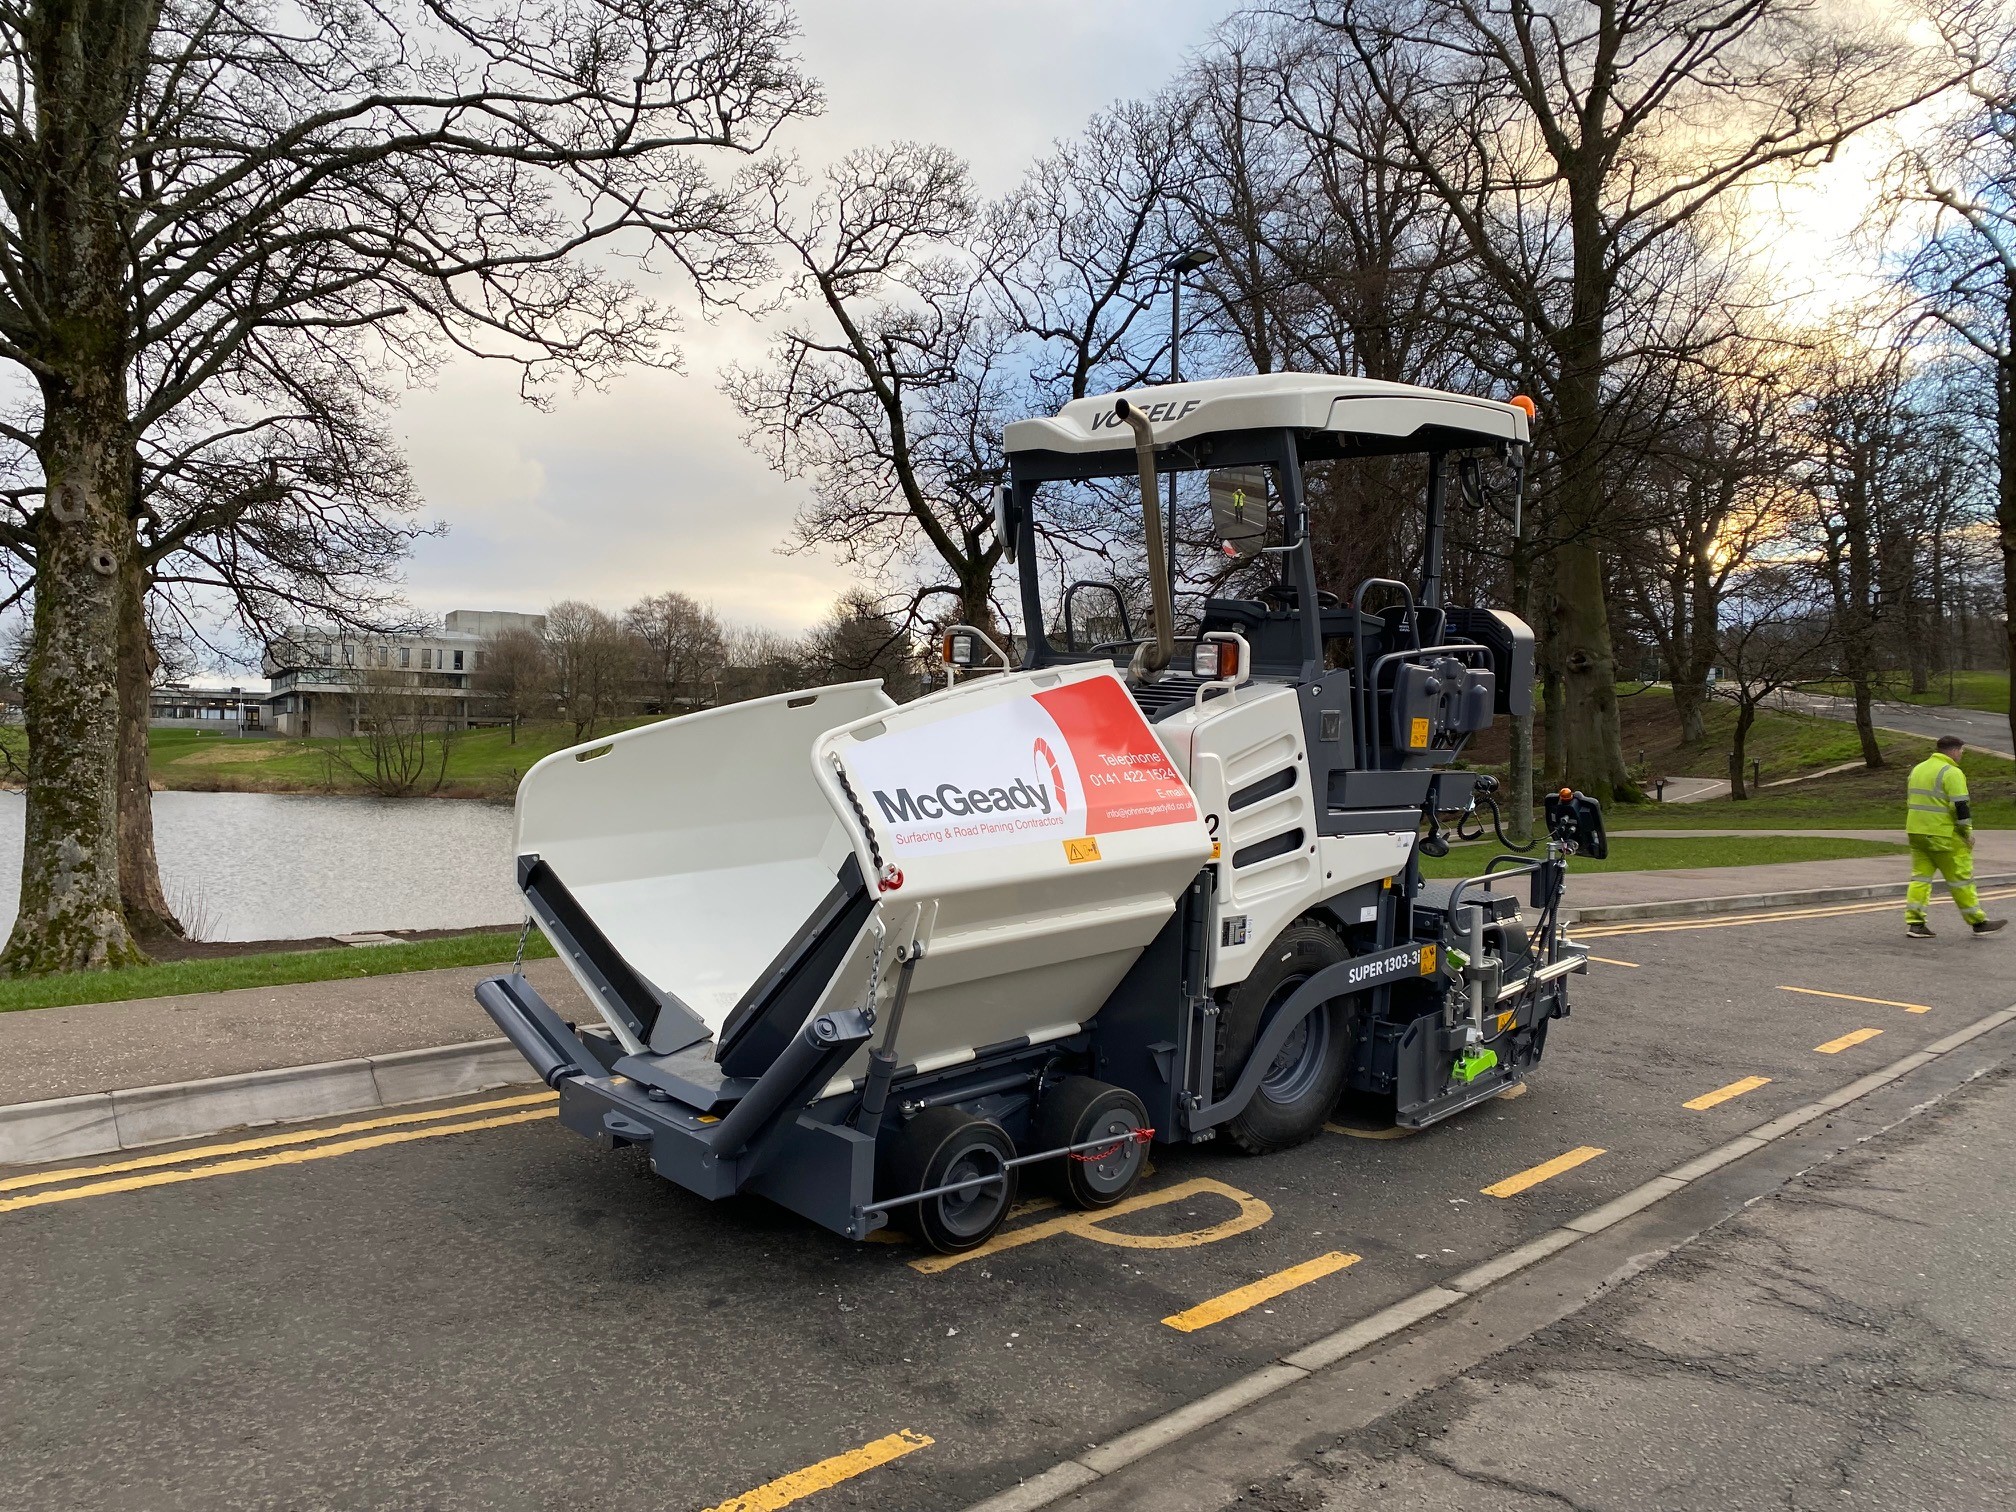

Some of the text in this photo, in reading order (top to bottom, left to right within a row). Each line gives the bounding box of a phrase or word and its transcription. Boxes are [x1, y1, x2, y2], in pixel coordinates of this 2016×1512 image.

[1098, 752, 1165, 767] Telephone:
[1089, 767, 1177, 787] 0141 422 1524
[872, 777, 1052, 823] McGeady
[1155, 788, 1188, 799] E-mail:
[896, 816, 1064, 845] Surfacing & Road Planing Contractors
[1348, 949, 1421, 984] SUPER 1303-3i
